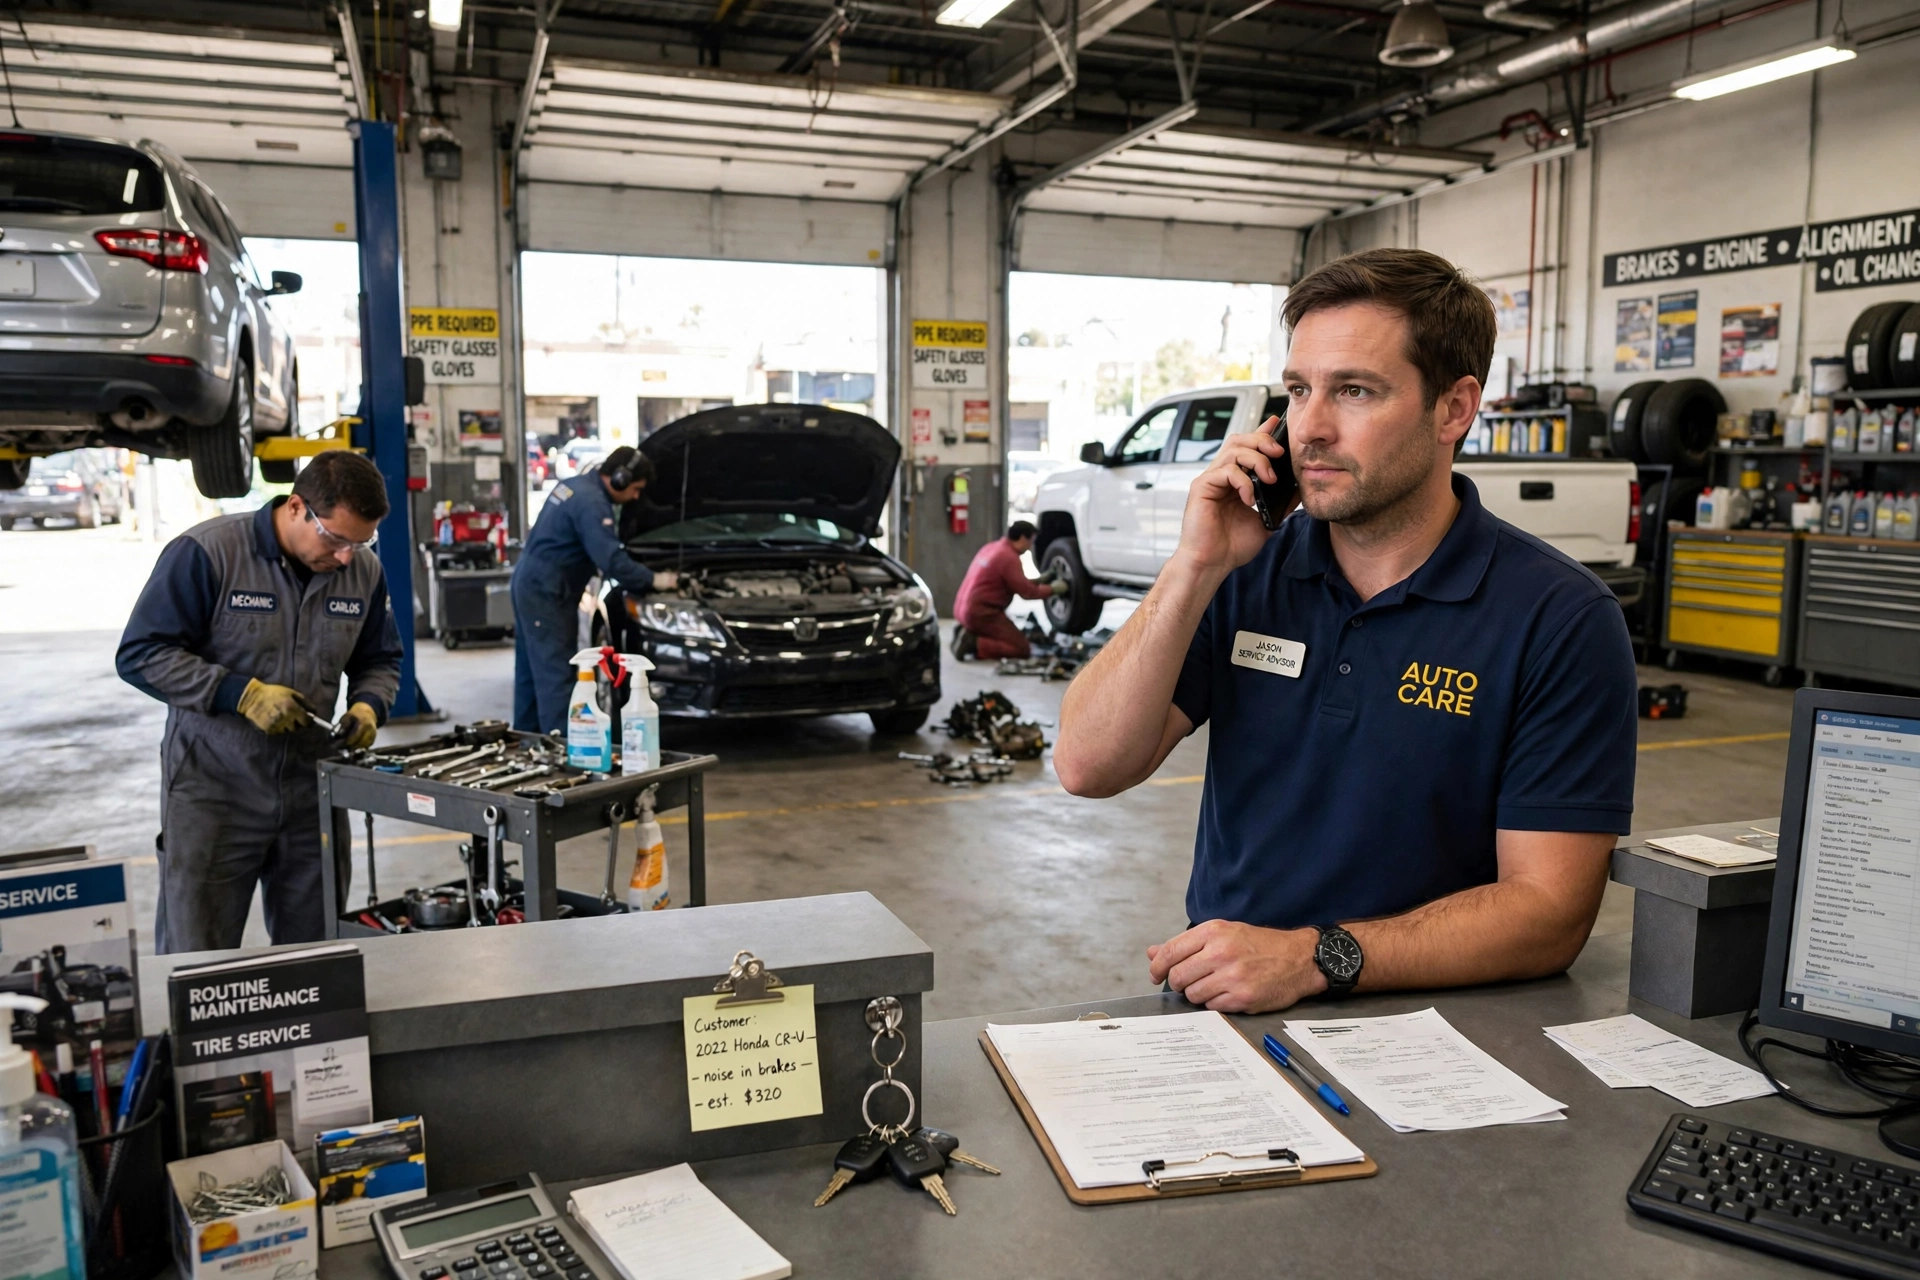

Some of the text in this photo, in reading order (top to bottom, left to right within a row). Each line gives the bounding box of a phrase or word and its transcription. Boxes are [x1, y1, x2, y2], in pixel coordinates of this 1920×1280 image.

[1615, 214, 1916, 282] BRAKES ENGINE ALIGNMENT
[1833, 249, 1920, 286] OIL CHANG
[411, 314, 496, 333] PPE REQUIRED
[915, 326, 985, 344] PPE REQUIRED
[411, 340, 497, 357] SAFETY GLASSES
[914, 348, 985, 365] SAFETY GLASSES
[432, 361, 475, 377] GLOVES
[932, 368, 967, 383] GLOVES
[231, 594, 274, 609] MECHANIC
[329, 601, 360, 615] CARLOS
[1256, 641, 1282, 653] JASON
[1400, 661, 1478, 693] AUTO
[1397, 683, 1475, 716] CARE
[0, 882, 78, 910] SERVICE
[189, 978, 270, 1004] ROUTINE
[190, 987, 320, 1022] MAINTENANCE
[192, 1023, 311, 1057] TIRE SERVICE
[696, 1040, 728, 1057] 2022
[734, 1035, 770, 1052] Honda
[704, 1068, 734, 1083] noise
[741, 1065, 752, 1078] in
[758, 1058, 797, 1076] brakes
[708, 1093, 733, 1109] est.
[744, 1087, 782, 1106] $320
